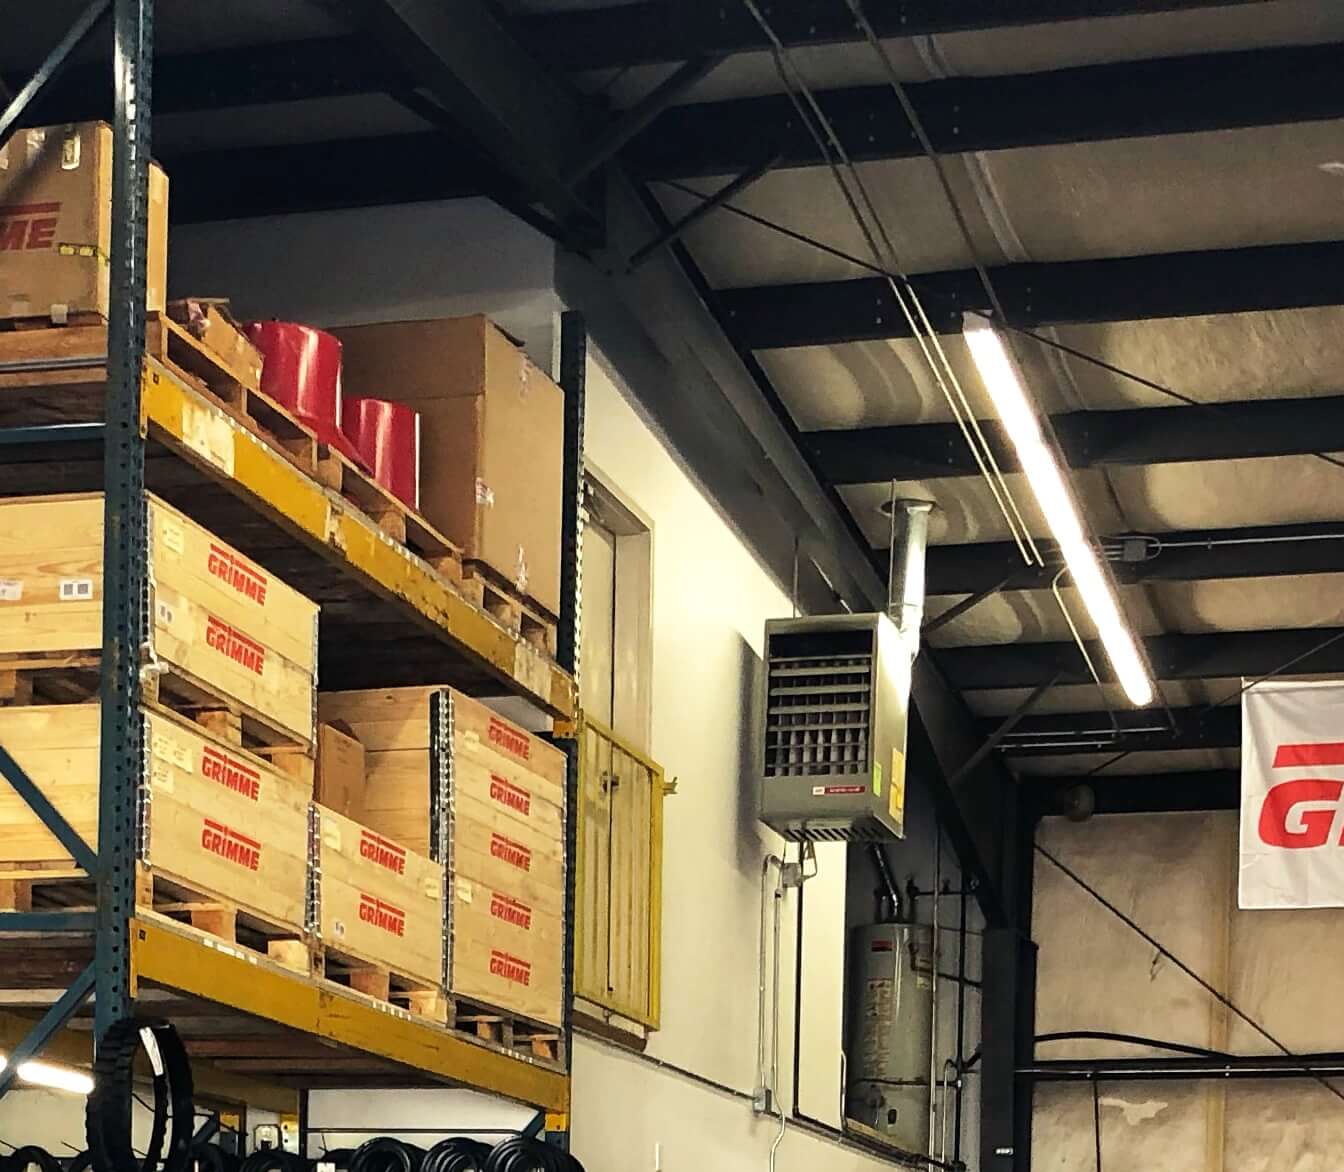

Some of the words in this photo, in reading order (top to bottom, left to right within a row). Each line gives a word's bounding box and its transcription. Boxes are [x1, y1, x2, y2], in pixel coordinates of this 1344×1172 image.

[208, 549, 266, 606] GRIMME
[206, 621, 265, 675] GRIMME
[488, 722, 530, 761] GRIMME
[202, 755, 261, 801] GRIMME
[490, 780, 531, 816] GRIMME
[202, 826, 261, 871] GRIMME
[360, 837, 406, 875] GRIMME
[490, 838, 531, 872] GRIMME
[359, 899, 405, 937] GRIMME
[490, 898, 531, 930] GRIMME
[490, 954, 531, 986] GRIMME
